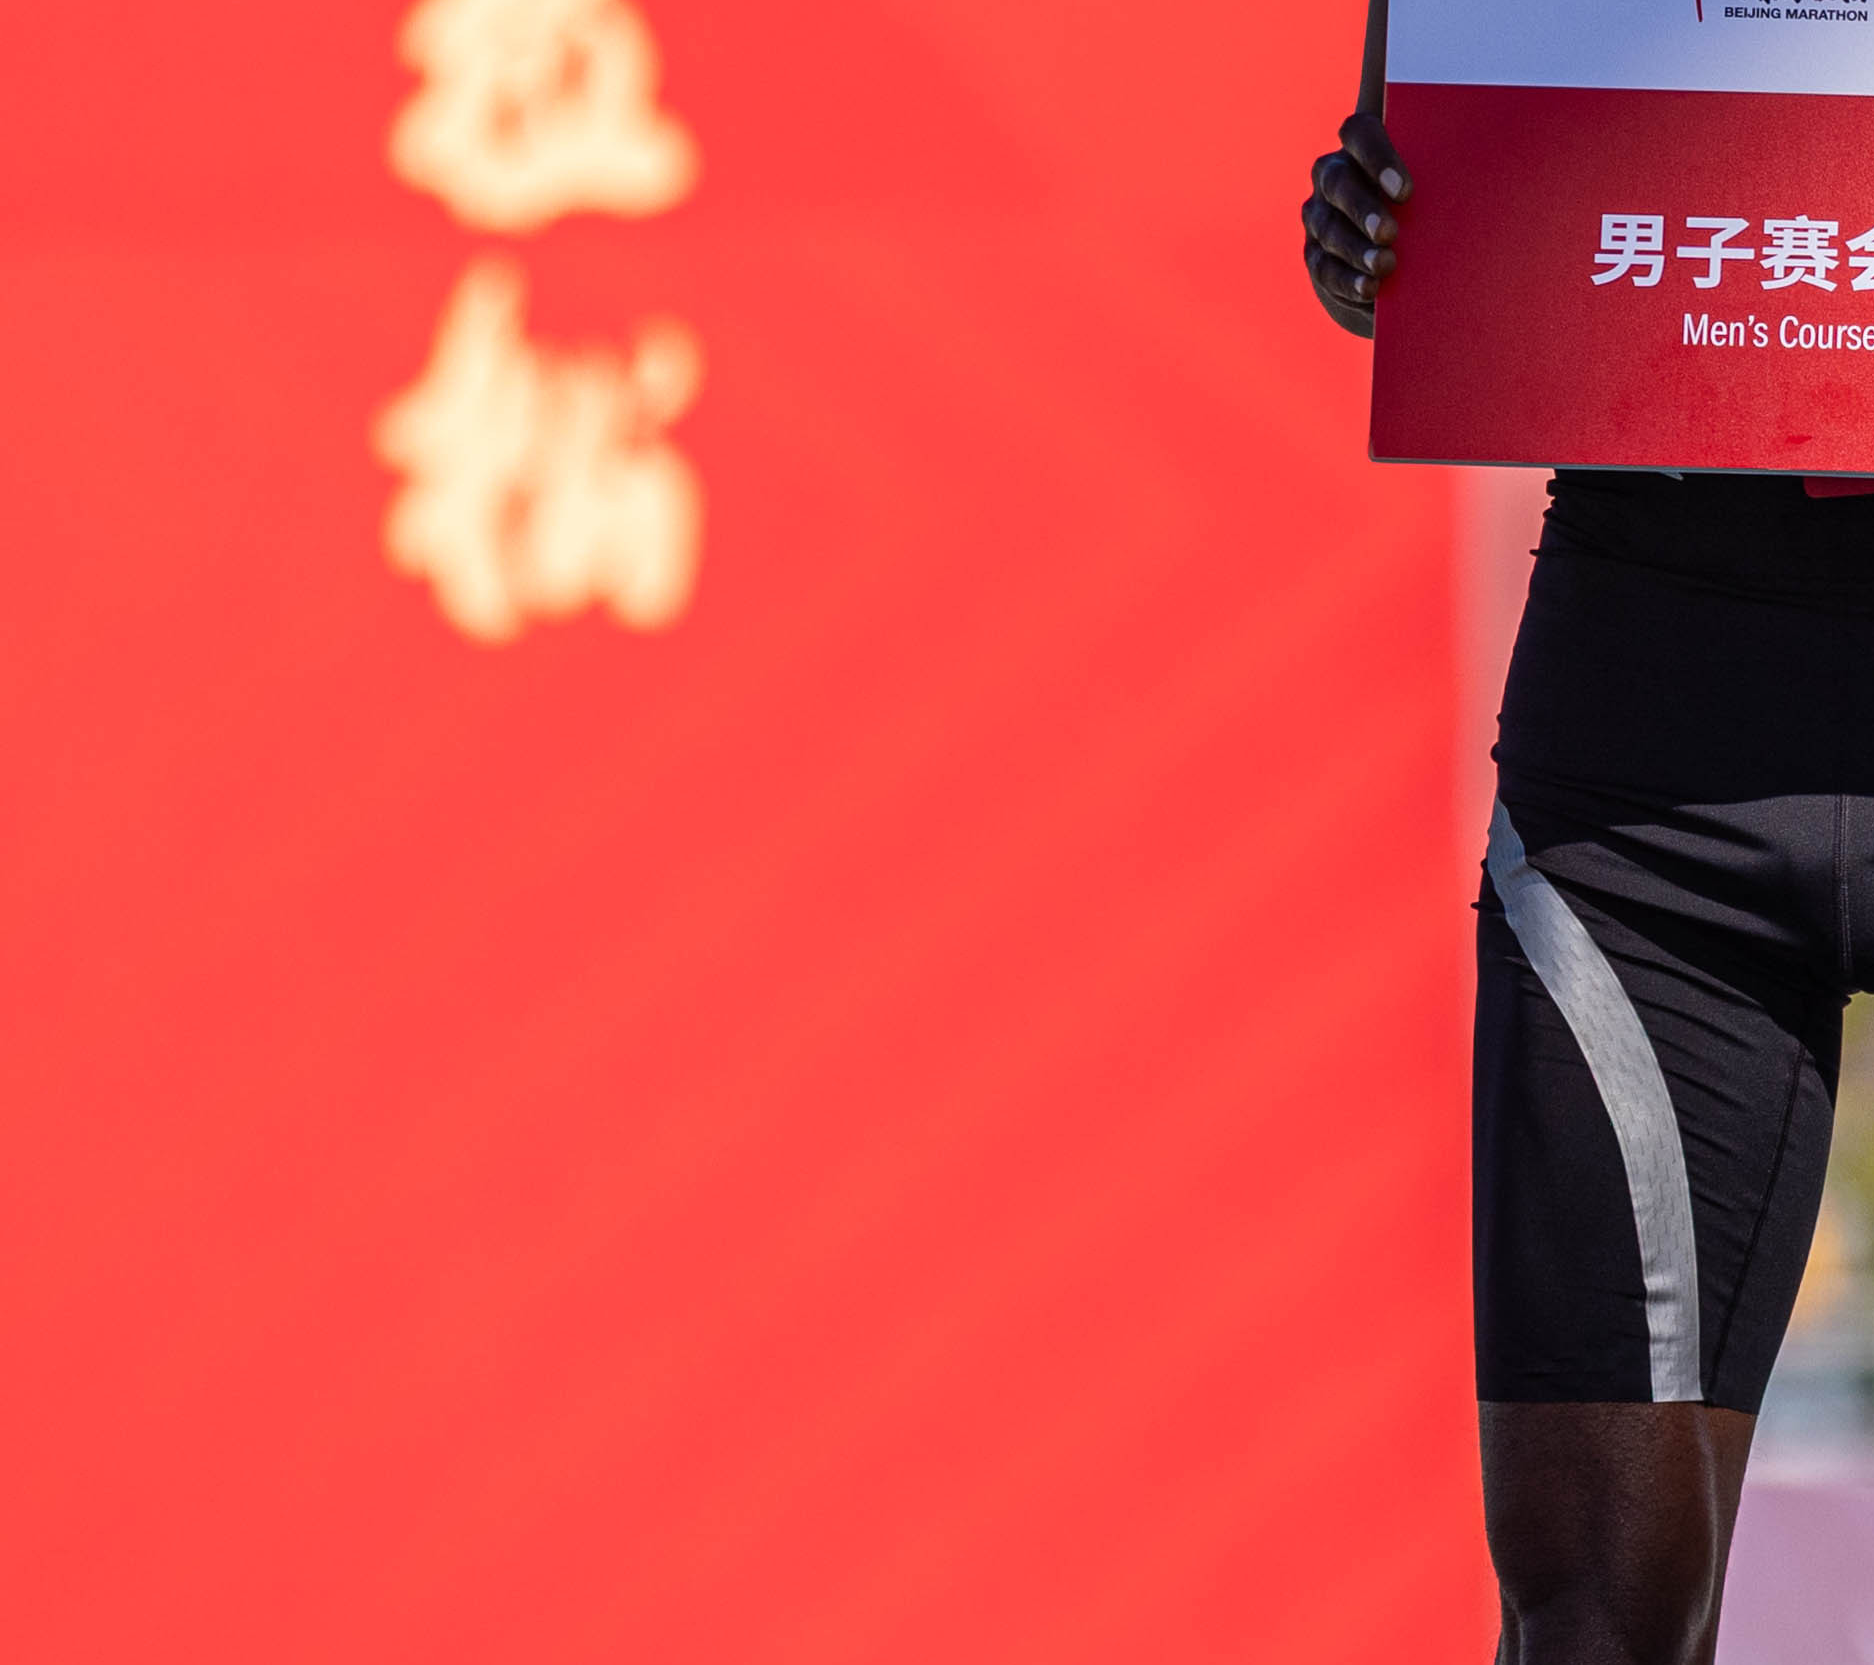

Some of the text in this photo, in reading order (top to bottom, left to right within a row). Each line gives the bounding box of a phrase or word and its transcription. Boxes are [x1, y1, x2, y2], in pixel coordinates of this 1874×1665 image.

[1724, 6, 1869, 22] BEIJING MARATHON
[1682, 312, 1769, 349] Men’s
